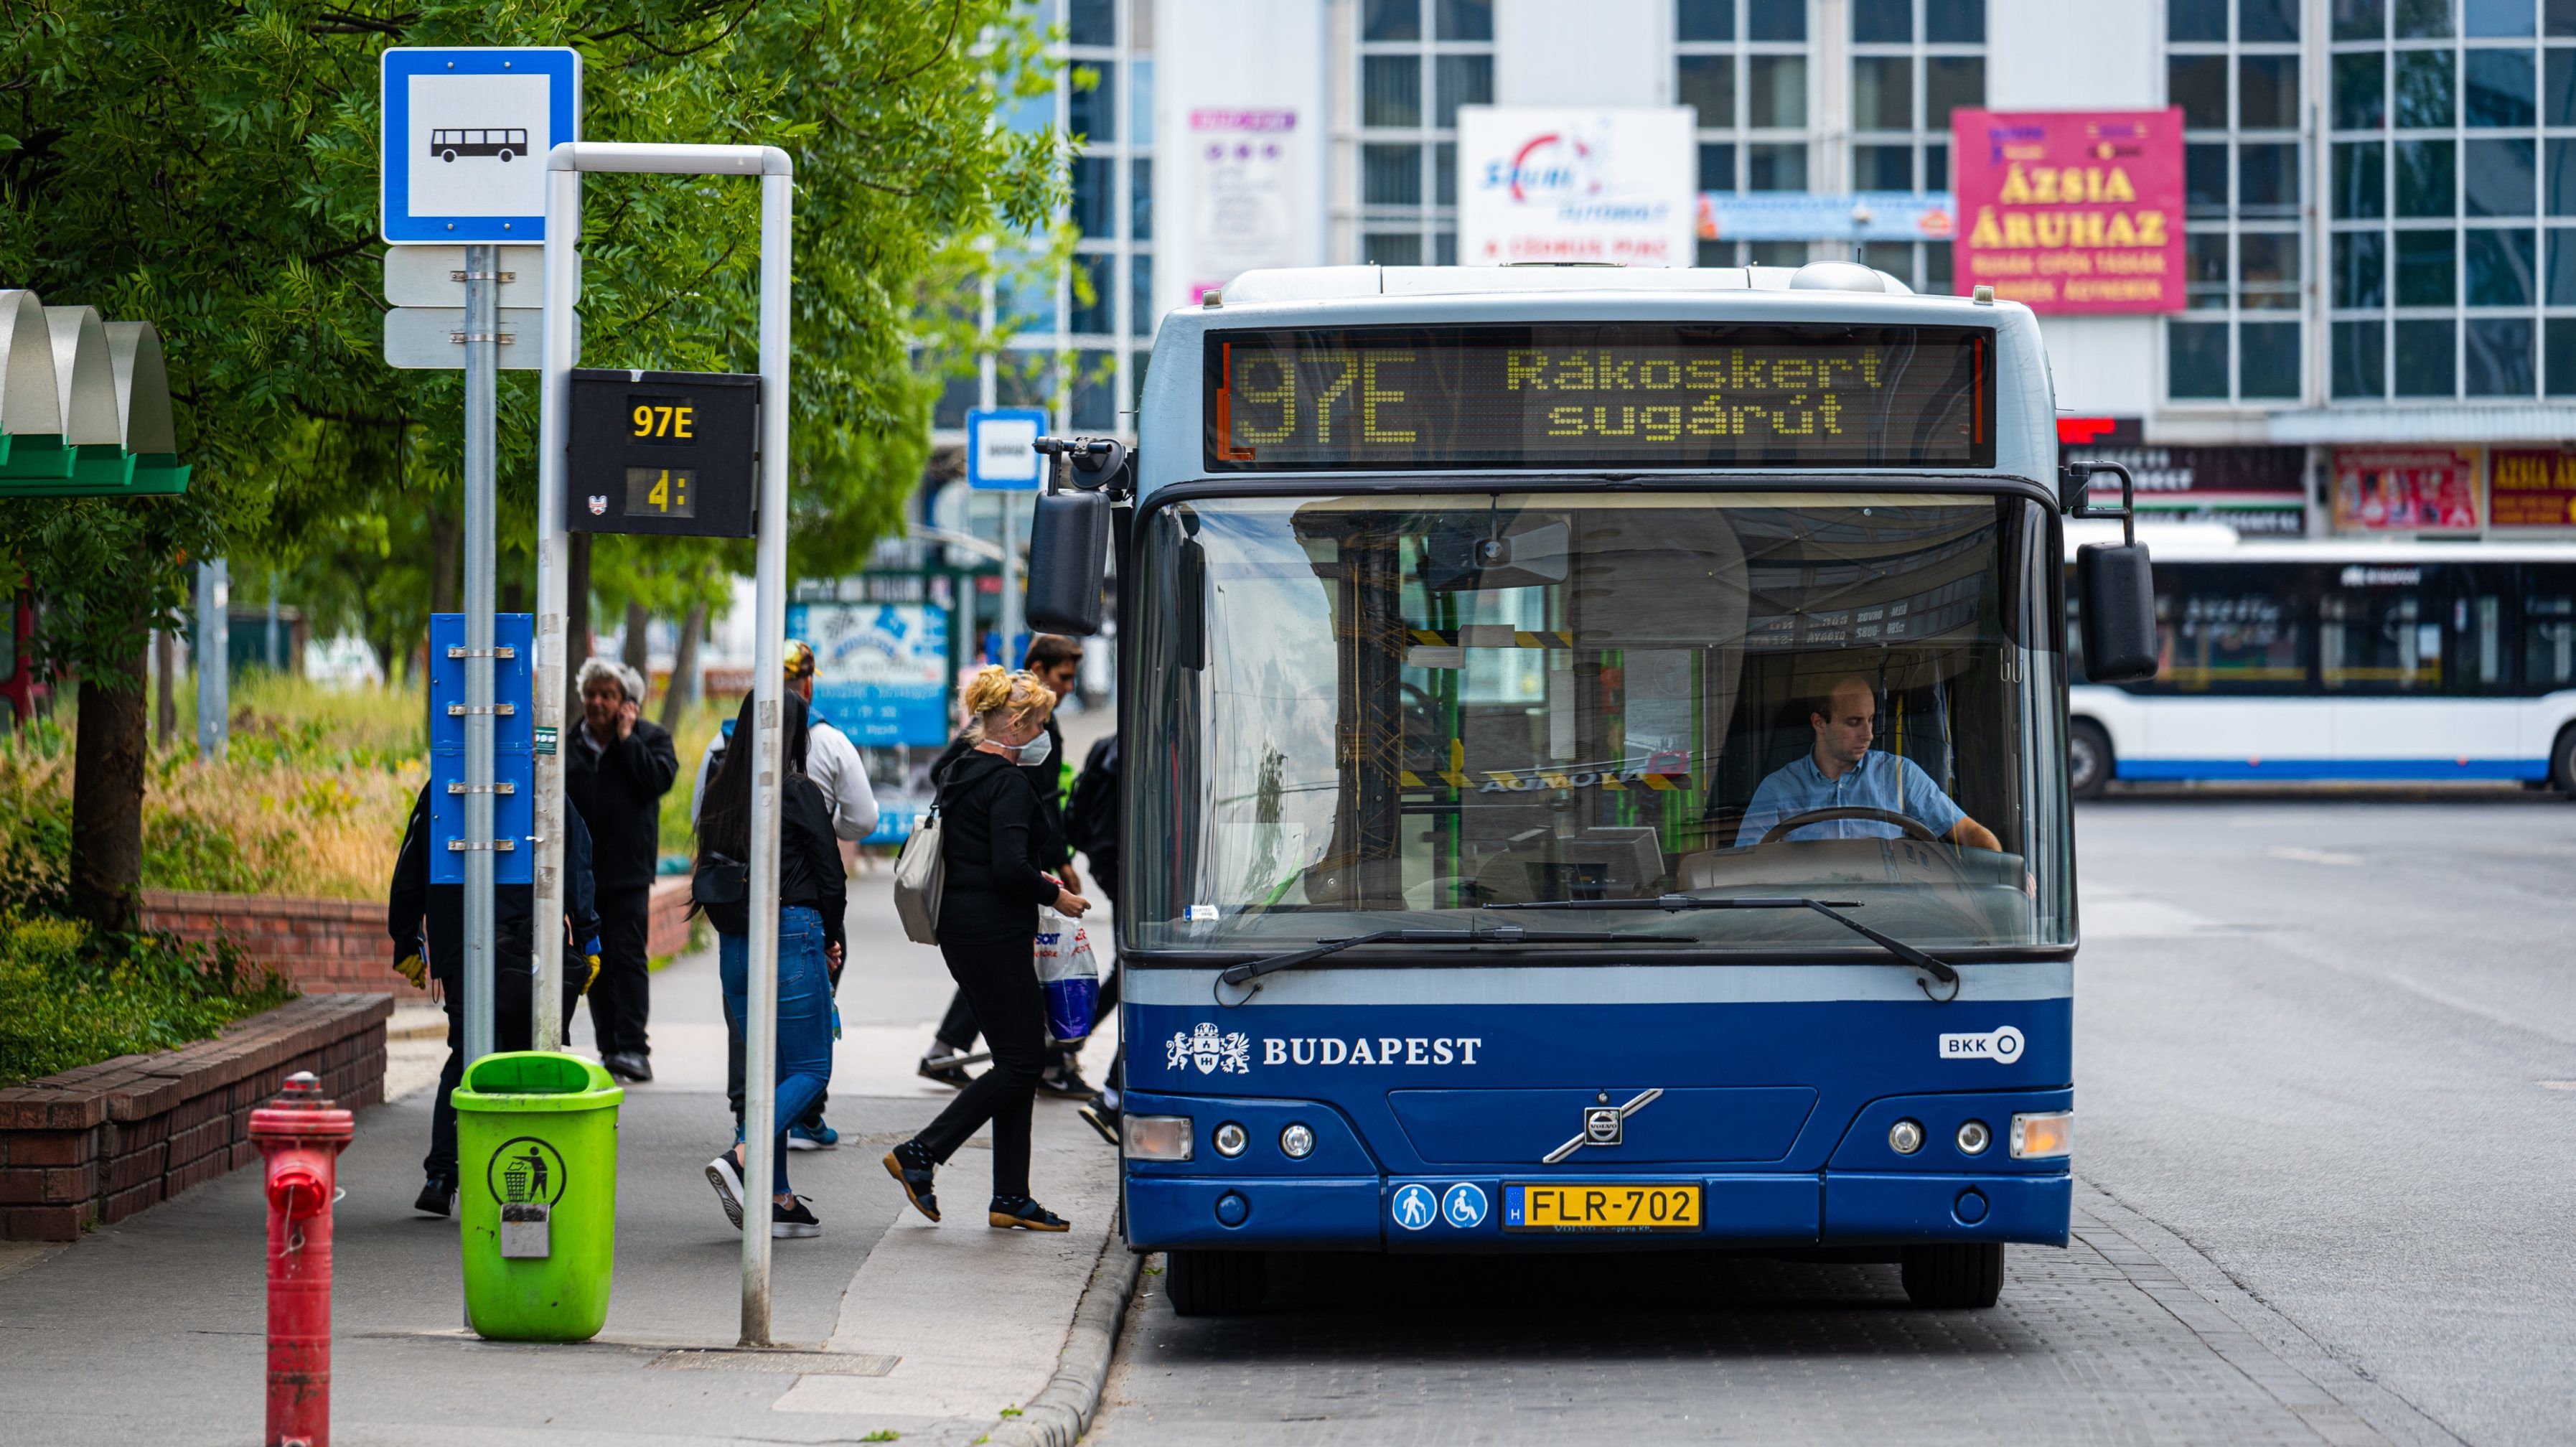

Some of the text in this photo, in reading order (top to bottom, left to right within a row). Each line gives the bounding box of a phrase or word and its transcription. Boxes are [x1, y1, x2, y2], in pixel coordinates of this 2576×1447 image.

[2000, 162, 2136, 205] ÁZSIA
[1237, 348, 1883, 444] 97E Rákoskert
[633, 406, 693, 439] 97E
[1548, 394, 1843, 442] sugárút
[1263, 1038, 1481, 1065] BUDAPEST
[1949, 1039, 1987, 1052] BKK
[1511, 1191, 1690, 1221] H FLR-702
